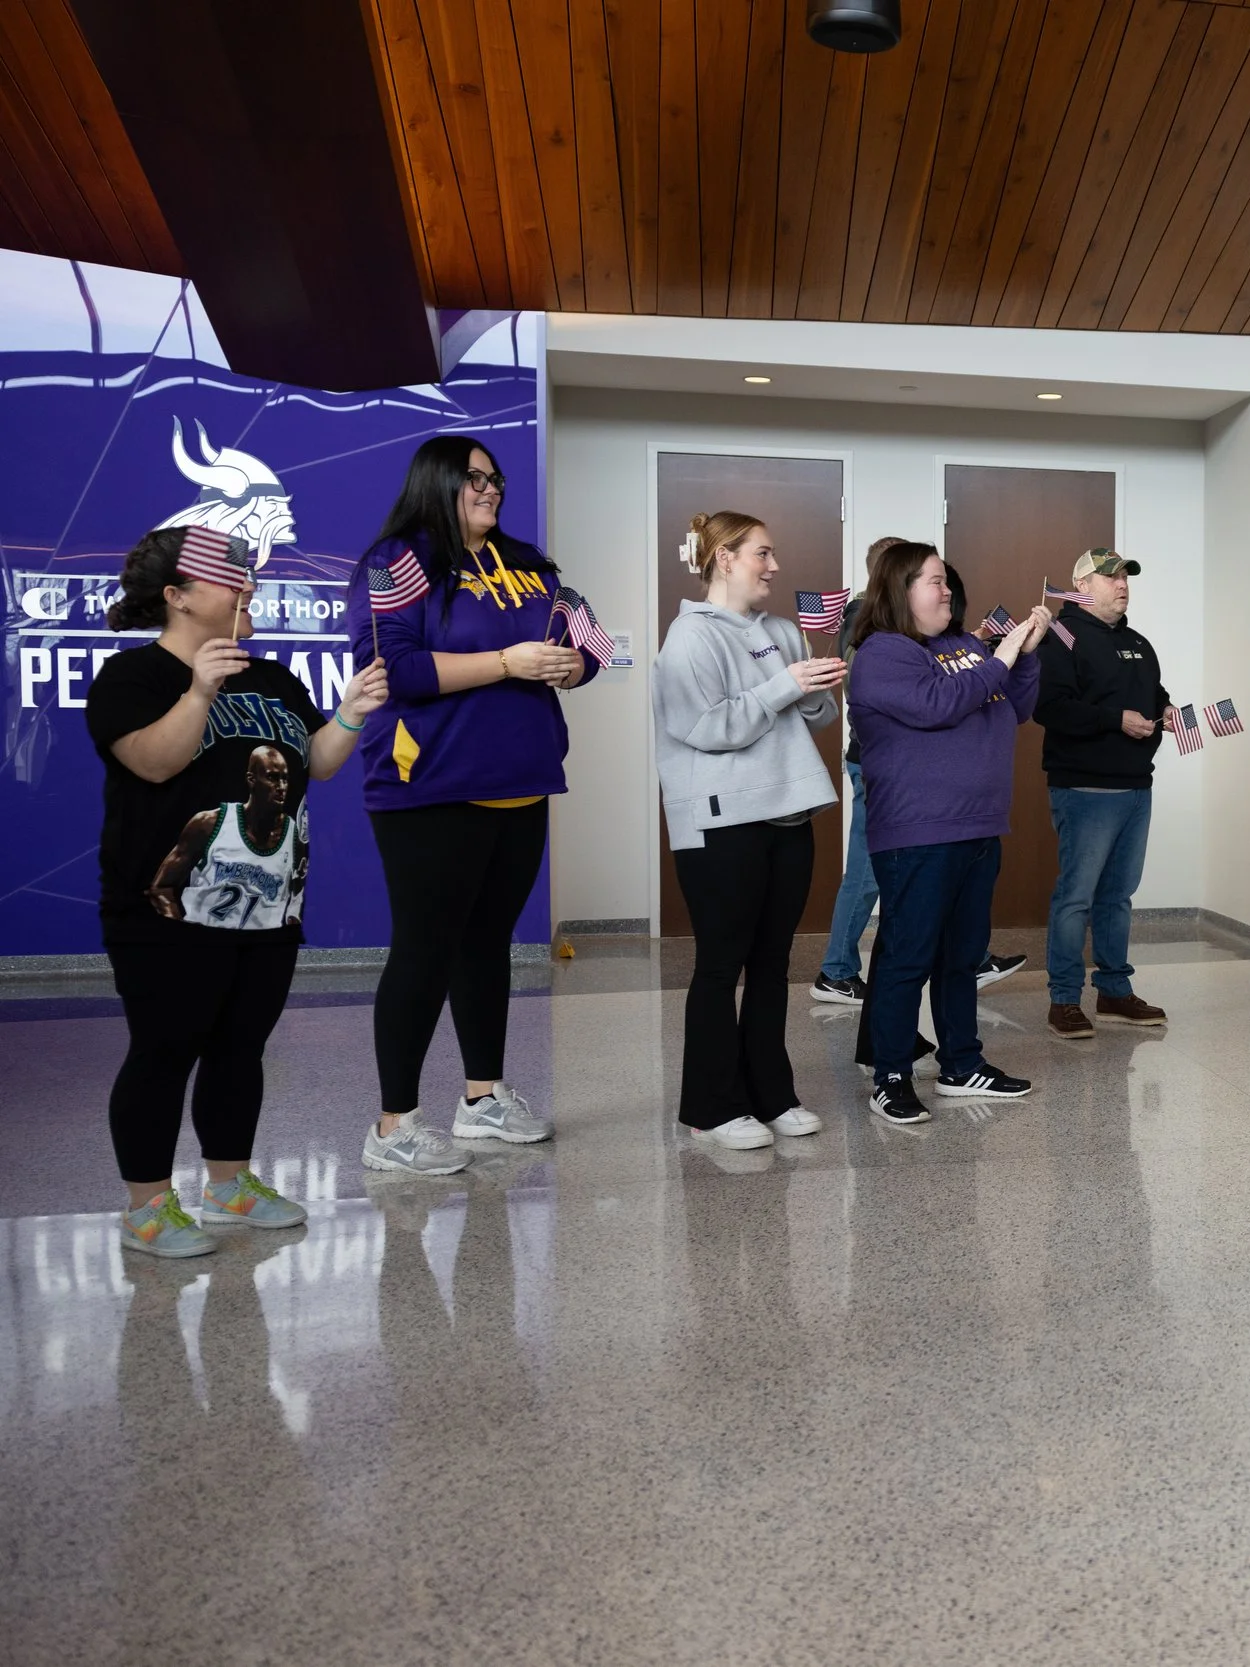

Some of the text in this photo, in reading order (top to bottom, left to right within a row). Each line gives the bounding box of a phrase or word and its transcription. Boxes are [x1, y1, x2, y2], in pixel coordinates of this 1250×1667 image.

[478, 568, 548, 595] MIN
[84, 595, 346, 619] TW ORTHOP
[208, 885, 260, 930] 21
